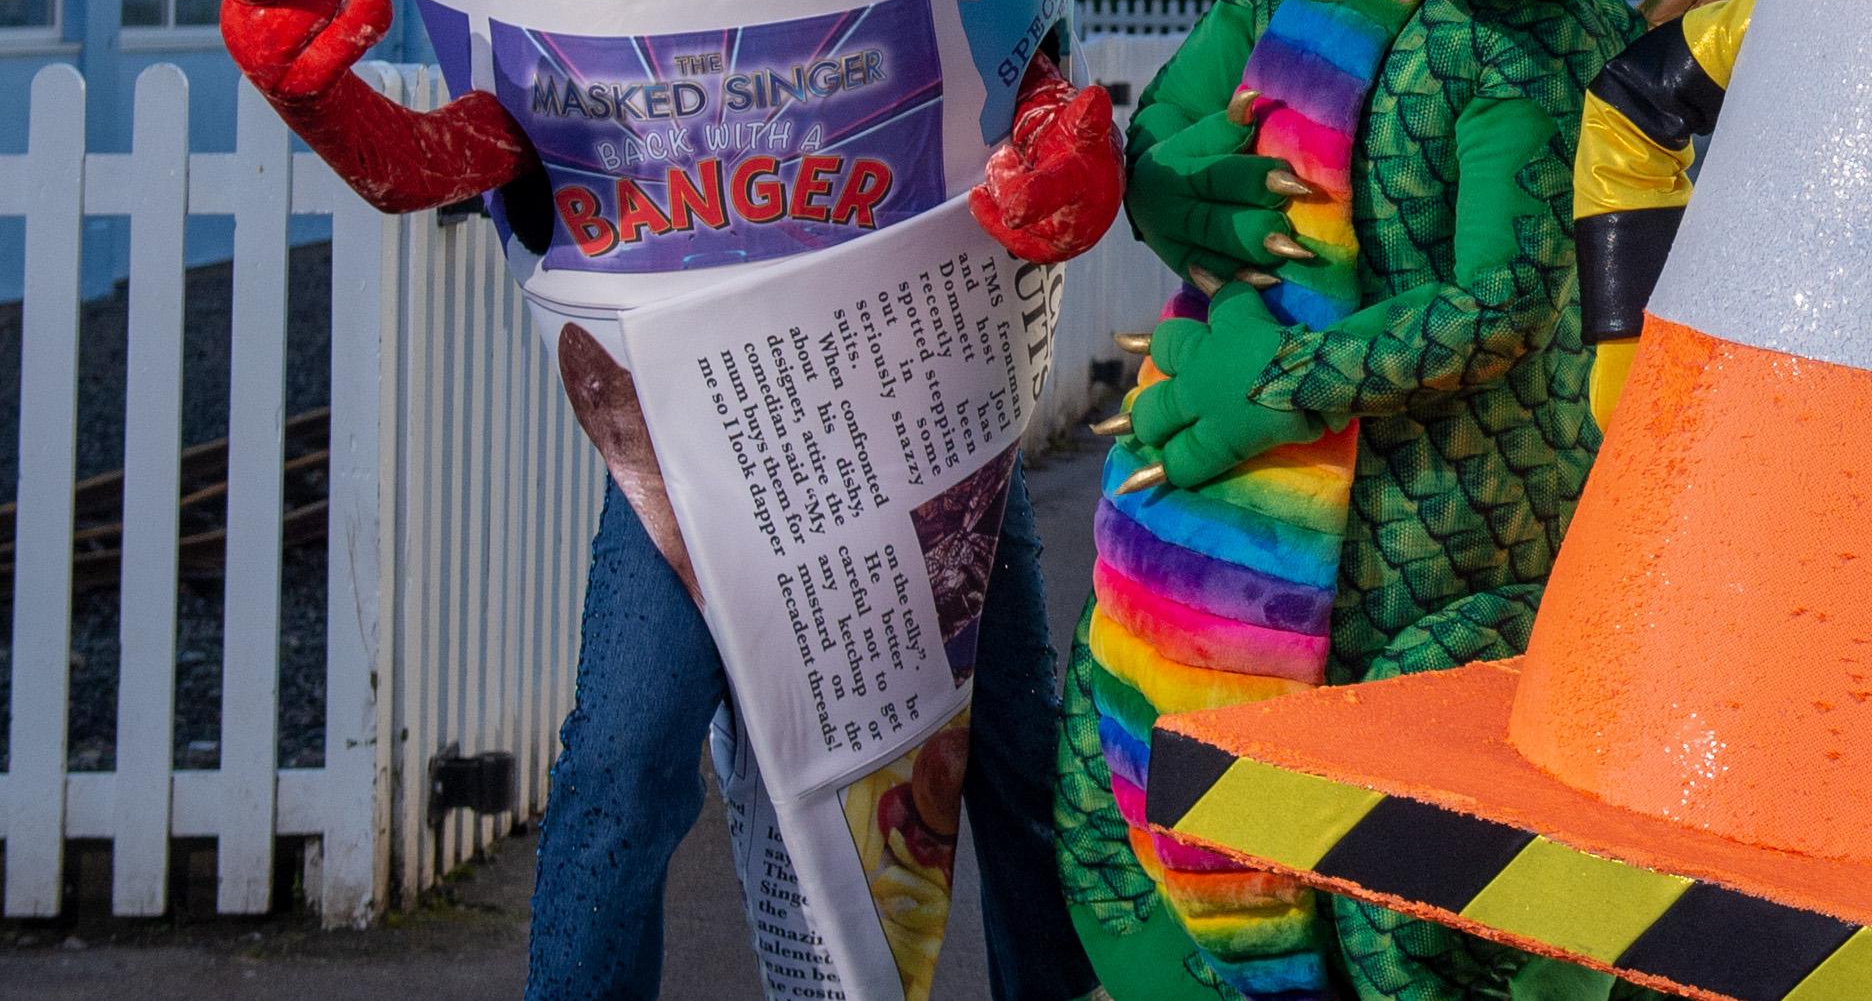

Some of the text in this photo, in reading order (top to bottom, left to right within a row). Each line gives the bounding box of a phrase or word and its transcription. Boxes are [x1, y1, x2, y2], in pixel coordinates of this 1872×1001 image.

[531, 47, 887, 122] MASKED SINGER
[597, 121, 824, 171] BACK WITH A
[674, 52, 724, 77] THE
[554, 154, 893, 258] BANGER
[743, 342, 788, 440] comedian
[781, 441, 810, 487] said
[833, 308, 860, 370] suits.
[855, 299, 924, 486] seriously snazzy
[878, 291, 942, 477] out in some
[897, 281, 960, 469] spotted stepping
[919, 271, 976, 456] recently been
[939, 259, 993, 443] Dommett has
[958, 252, 1011, 433] and host Joel
[981, 256, 1022, 420] TMS frontman
[1007, 248, 1049, 402] UITS
[697, 356, 786, 557] me so I look dapper
[720, 349, 806, 545] mum buys them for
[766, 334, 845, 527] designer, attire the
[788, 326, 865, 519] about his dishy,
[818, 330, 890, 509] When confronted
[776, 572, 843, 752] decadent threads!
[796, 562, 863, 752] mustard on the
[817, 554, 883, 741] any ketchup or
[838, 545, 903, 733] careful not to get
[863, 550, 920, 721] He better be
[884, 544, 899, 571] on
[892, 572, 910, 606] the
[759, 899, 788, 919] the
